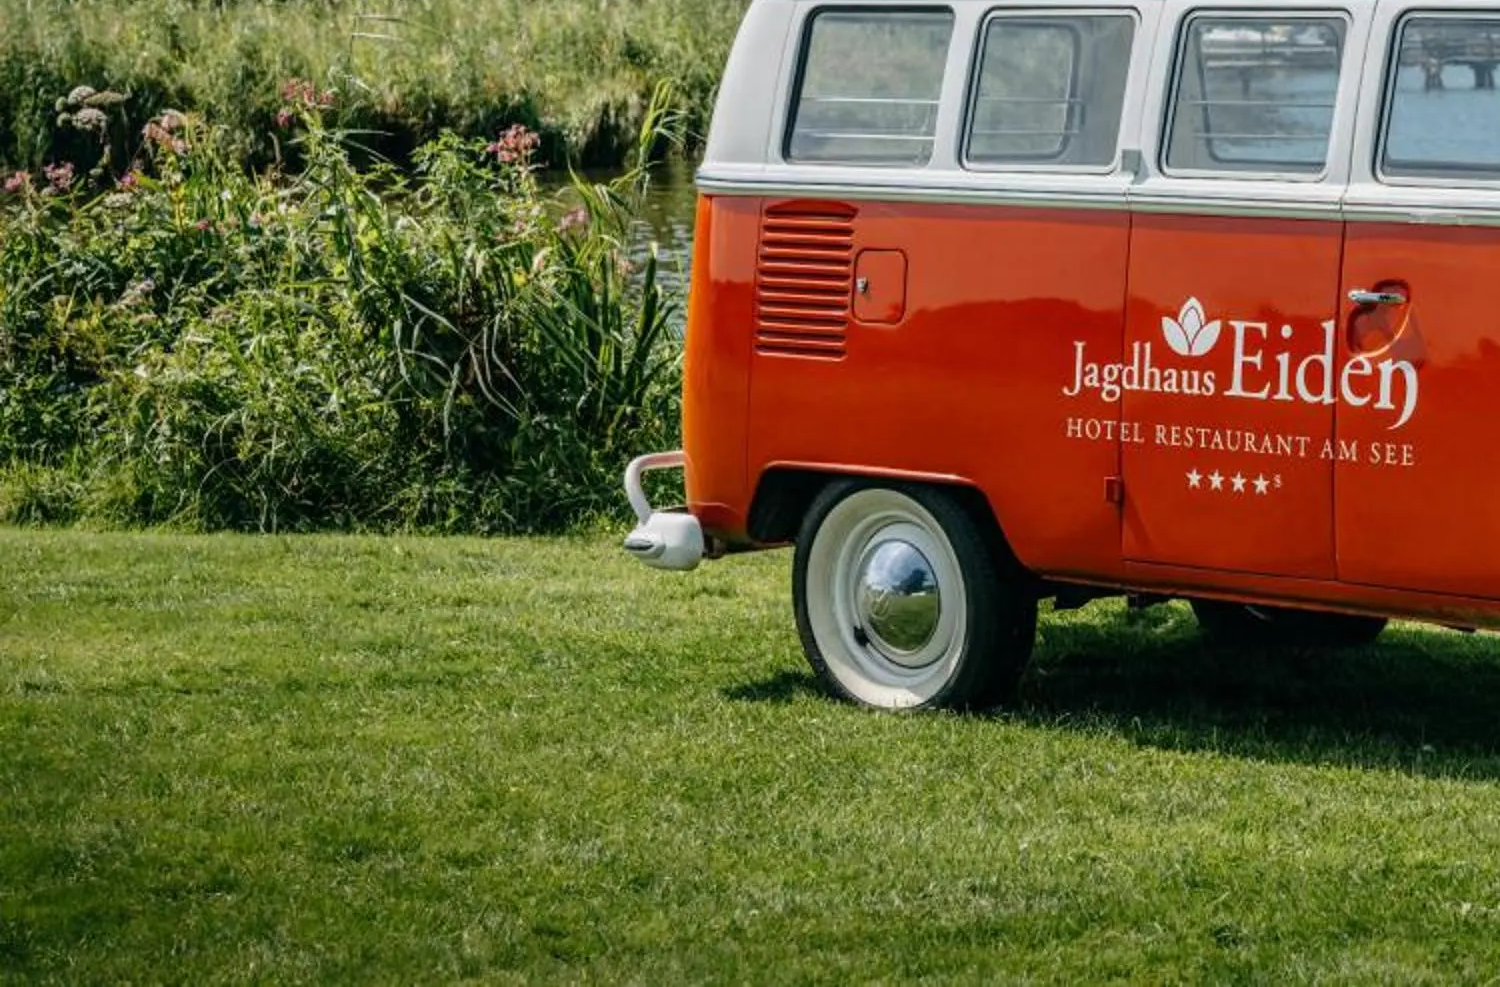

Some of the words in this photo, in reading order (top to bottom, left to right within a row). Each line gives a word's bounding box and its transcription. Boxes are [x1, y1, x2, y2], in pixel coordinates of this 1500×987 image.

[1063, 340, 1216, 402] Jagdhaus
[1223, 319, 1418, 430] Eiden
[1066, 417, 1145, 443] HOTEL
[1155, 424, 1310, 458] RESTAURANT
[1320, 438, 1358, 462] AM
[1369, 441, 1415, 466] SEE
